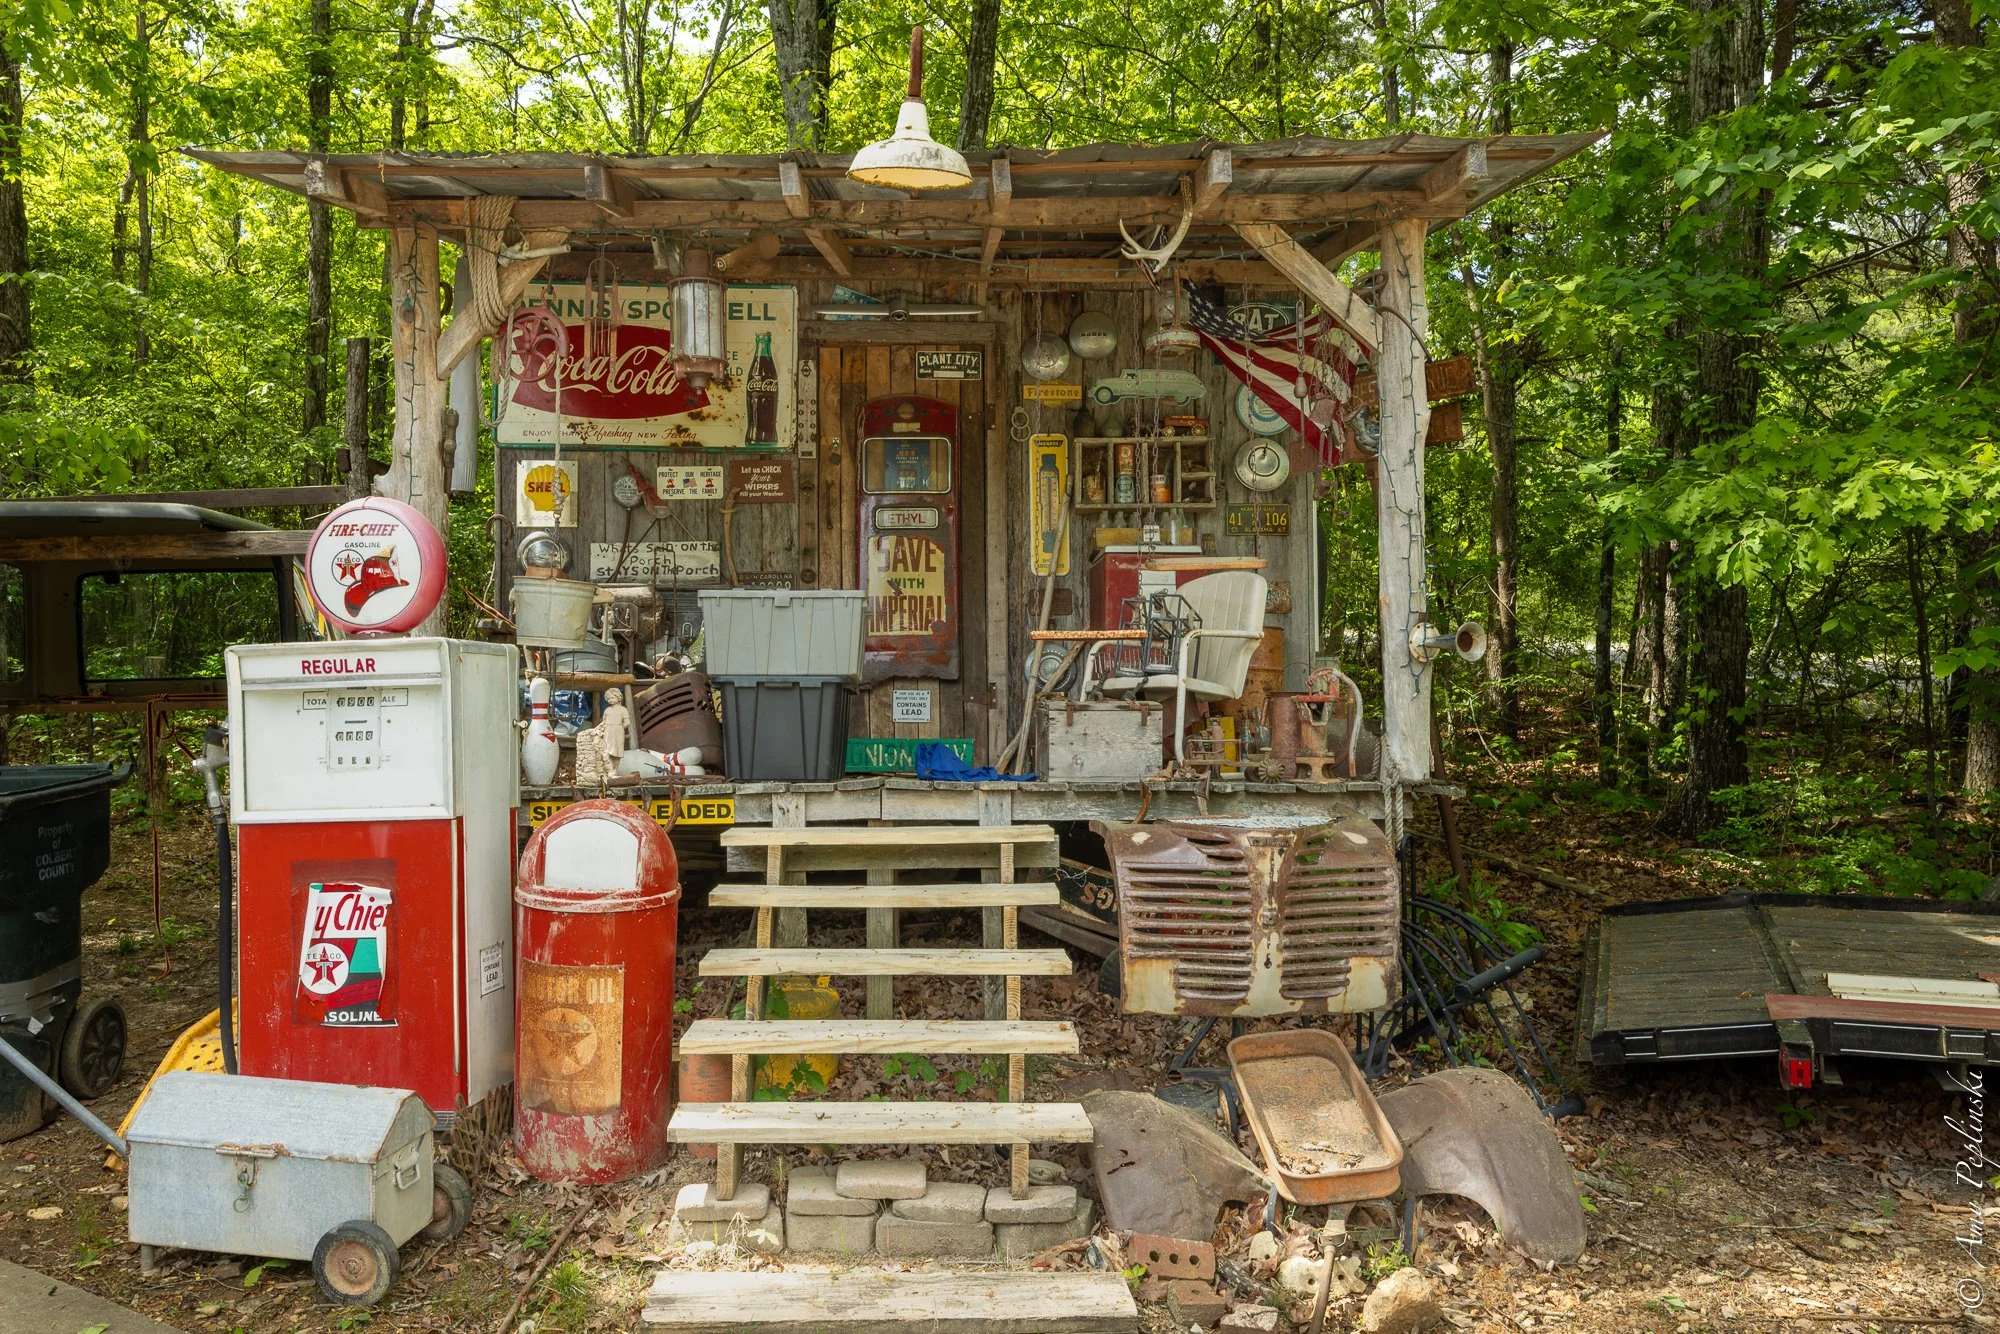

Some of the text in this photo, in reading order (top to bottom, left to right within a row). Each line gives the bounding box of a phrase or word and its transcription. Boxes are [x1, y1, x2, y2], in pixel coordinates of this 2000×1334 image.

[519, 298, 612, 318] NNIS
[727, 302, 777, 321] ELL
[919, 353, 978, 367] PLANT CITY
[1026, 387, 1080, 398] Firestone
[522, 429, 552, 437] ENJOY
[585, 425, 634, 443] Refreshing
[741, 465, 752, 474] Let
[761, 465, 782, 474] CHECK
[527, 481, 566, 493] SHEL
[887, 513, 926, 524] ETHYL
[1228, 512, 1243, 526] 41
[1265, 512, 1287, 526] 106
[328, 523, 399, 537] FIRE-CHIEF
[344, 541, 381, 549] GASOLINE
[599, 543, 639, 554] Whts
[877, 536, 937, 573] SAVE
[889, 577, 925, 589] WITH
[869, 595, 942, 633] IMPERIAL
[301, 658, 376, 675] REGULAR
[306, 695, 397, 706] TOTA ALE
[896, 701, 927, 709] CONTAINS
[901, 708, 923, 716] LEAD
[638, 803, 734, 820] EADED.
[38, 823, 73, 840] Property
[52, 836, 62, 850] of
[38, 862, 75, 881] COUNTY
[314, 893, 385, 939] y Chie
[307, 952, 342, 960] TEXACO
[486, 971, 499, 983] LEAD
[585, 977, 616, 1005] OIL
[324, 1011, 383, 1022] SOLINE
